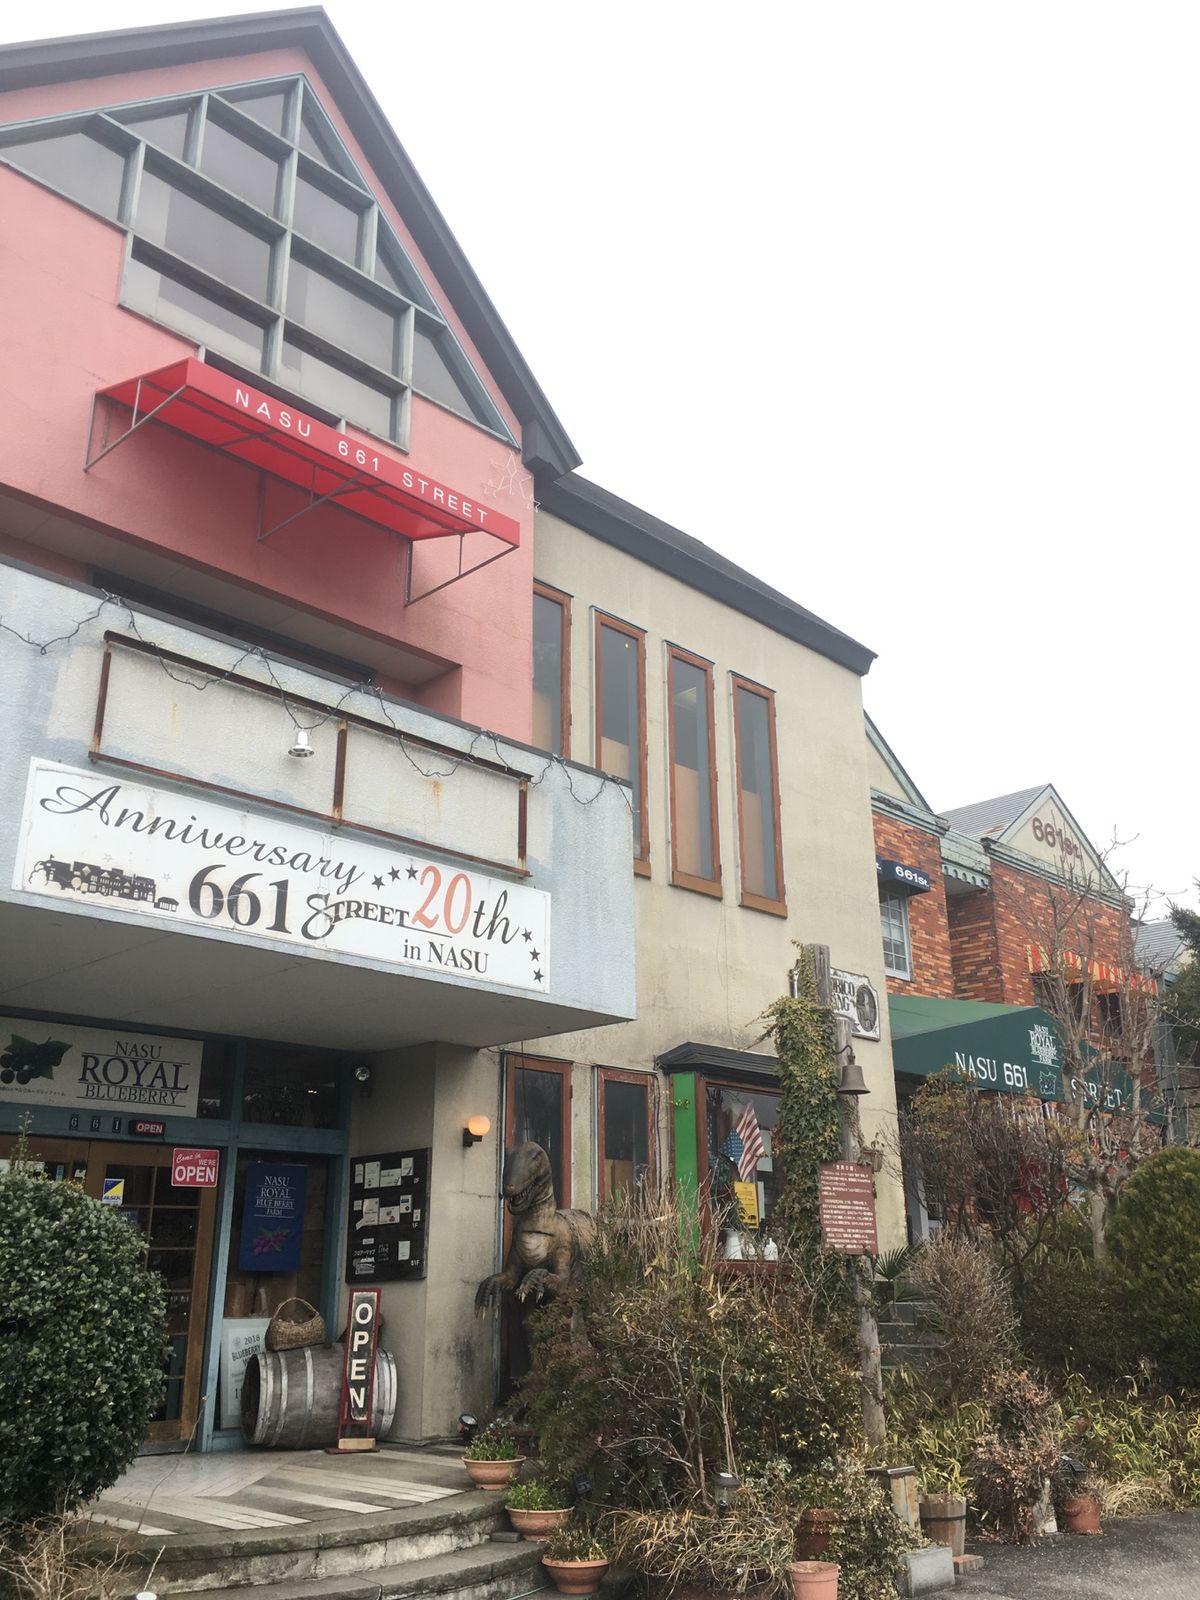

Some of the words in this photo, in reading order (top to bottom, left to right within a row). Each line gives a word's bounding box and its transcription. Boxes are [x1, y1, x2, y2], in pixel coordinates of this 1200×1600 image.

[235, 388, 311, 437] NASU
[338, 440, 379, 471] 661
[402, 472, 488, 524] STREET
[39, 784, 365, 895] Anniversary
[188, 864, 293, 934] 661
[411, 864, 520, 945] 20th
[403, 938, 422, 961] in
[427, 940, 489, 974] NASU
[115, 1040, 163, 1060] NASU
[1030, 1030, 1056, 1050] ROYAL
[78, 1053, 190, 1091] ROYAL
[954, 1051, 998, 1082] NASU
[1003, 1062, 1029, 1089] 661
[85, 1084, 180, 1105] BLUEBERRY
[136, 1123, 163, 1134] OPEN
[176, 1152, 194, 1164] Come
[174, 1166, 216, 1182] OPEN
[264, 1175, 290, 1187] NASU
[261, 1187, 290, 1199] ROYAL
[244, 1334, 261, 1345] 2018
[231, 1344, 261, 1361] BLUEBERRY
[349, 1303, 373, 1409] OPEN
